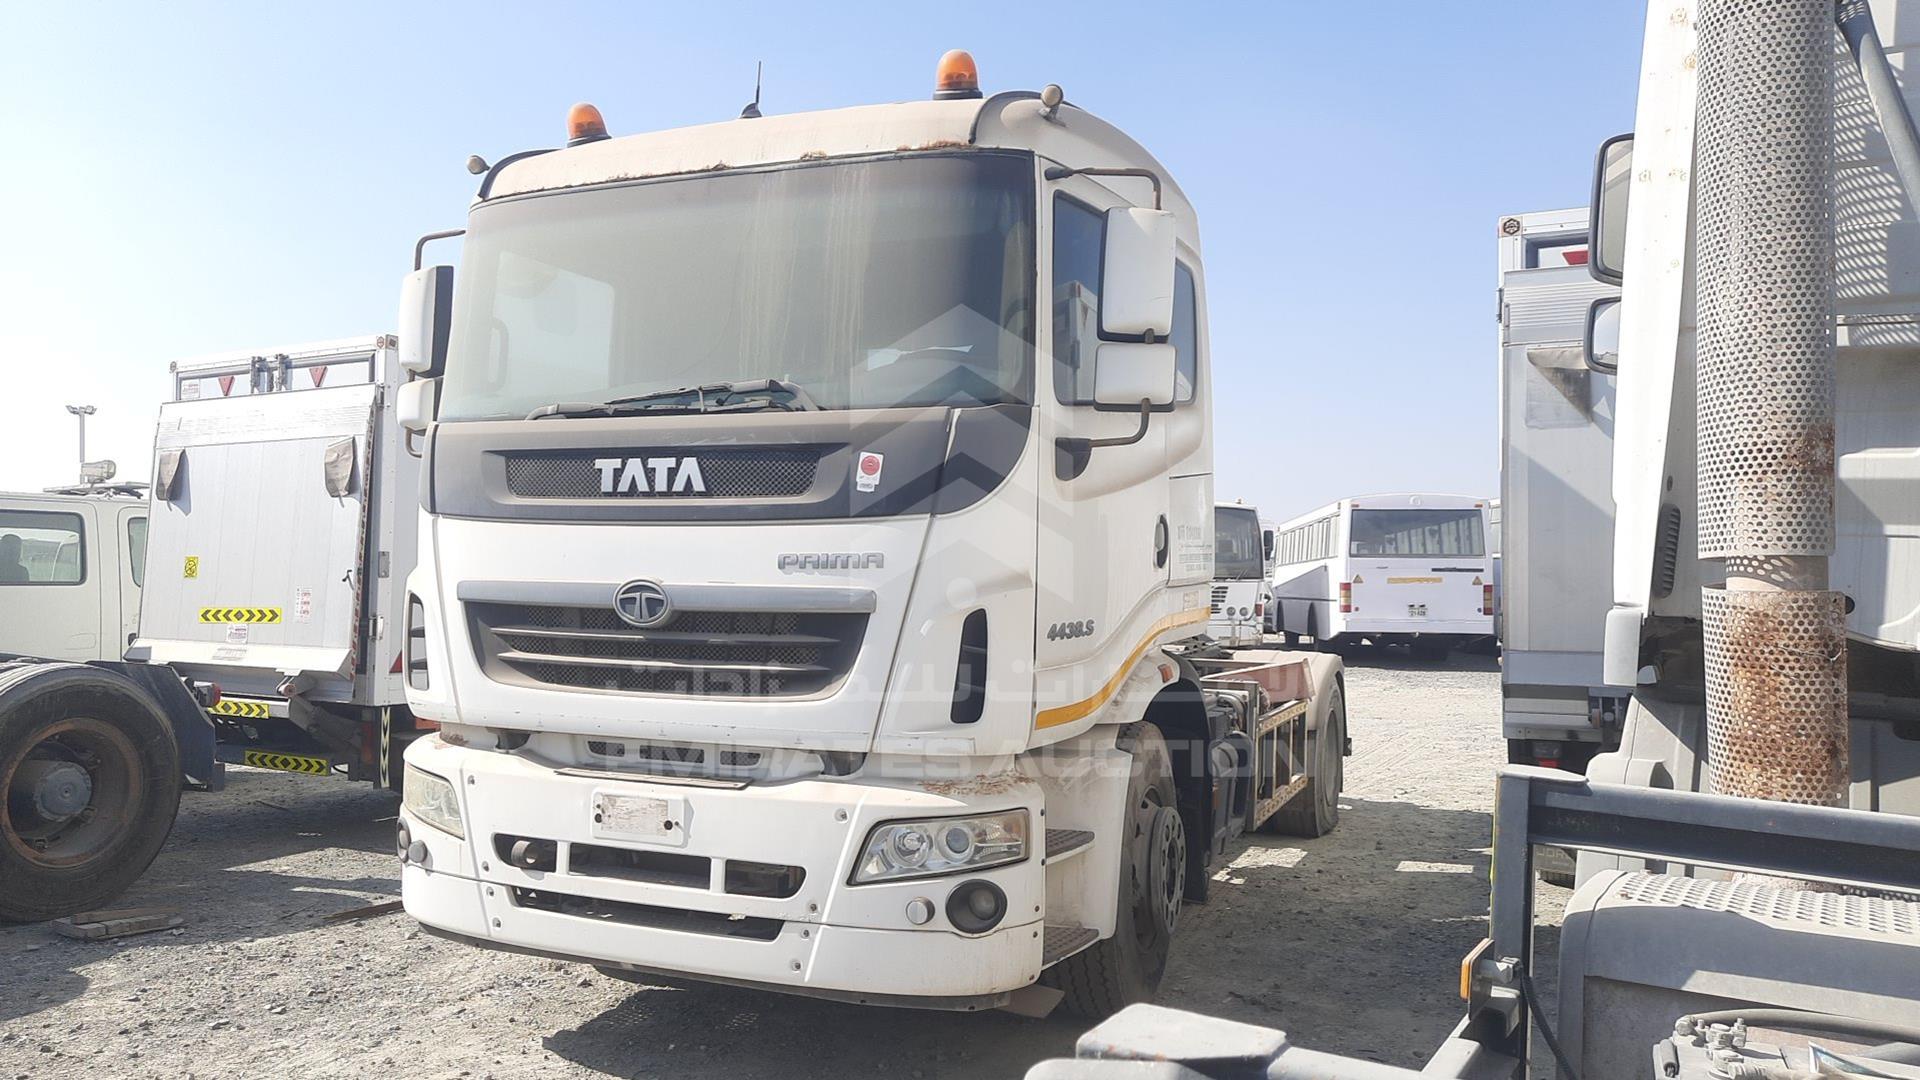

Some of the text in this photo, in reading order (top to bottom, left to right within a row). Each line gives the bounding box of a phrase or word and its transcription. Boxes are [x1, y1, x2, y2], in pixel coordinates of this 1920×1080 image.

[594, 457, 706, 493] TATA
[778, 552, 884, 570] PRIMA
[1046, 619, 1095, 642] 4438.S
